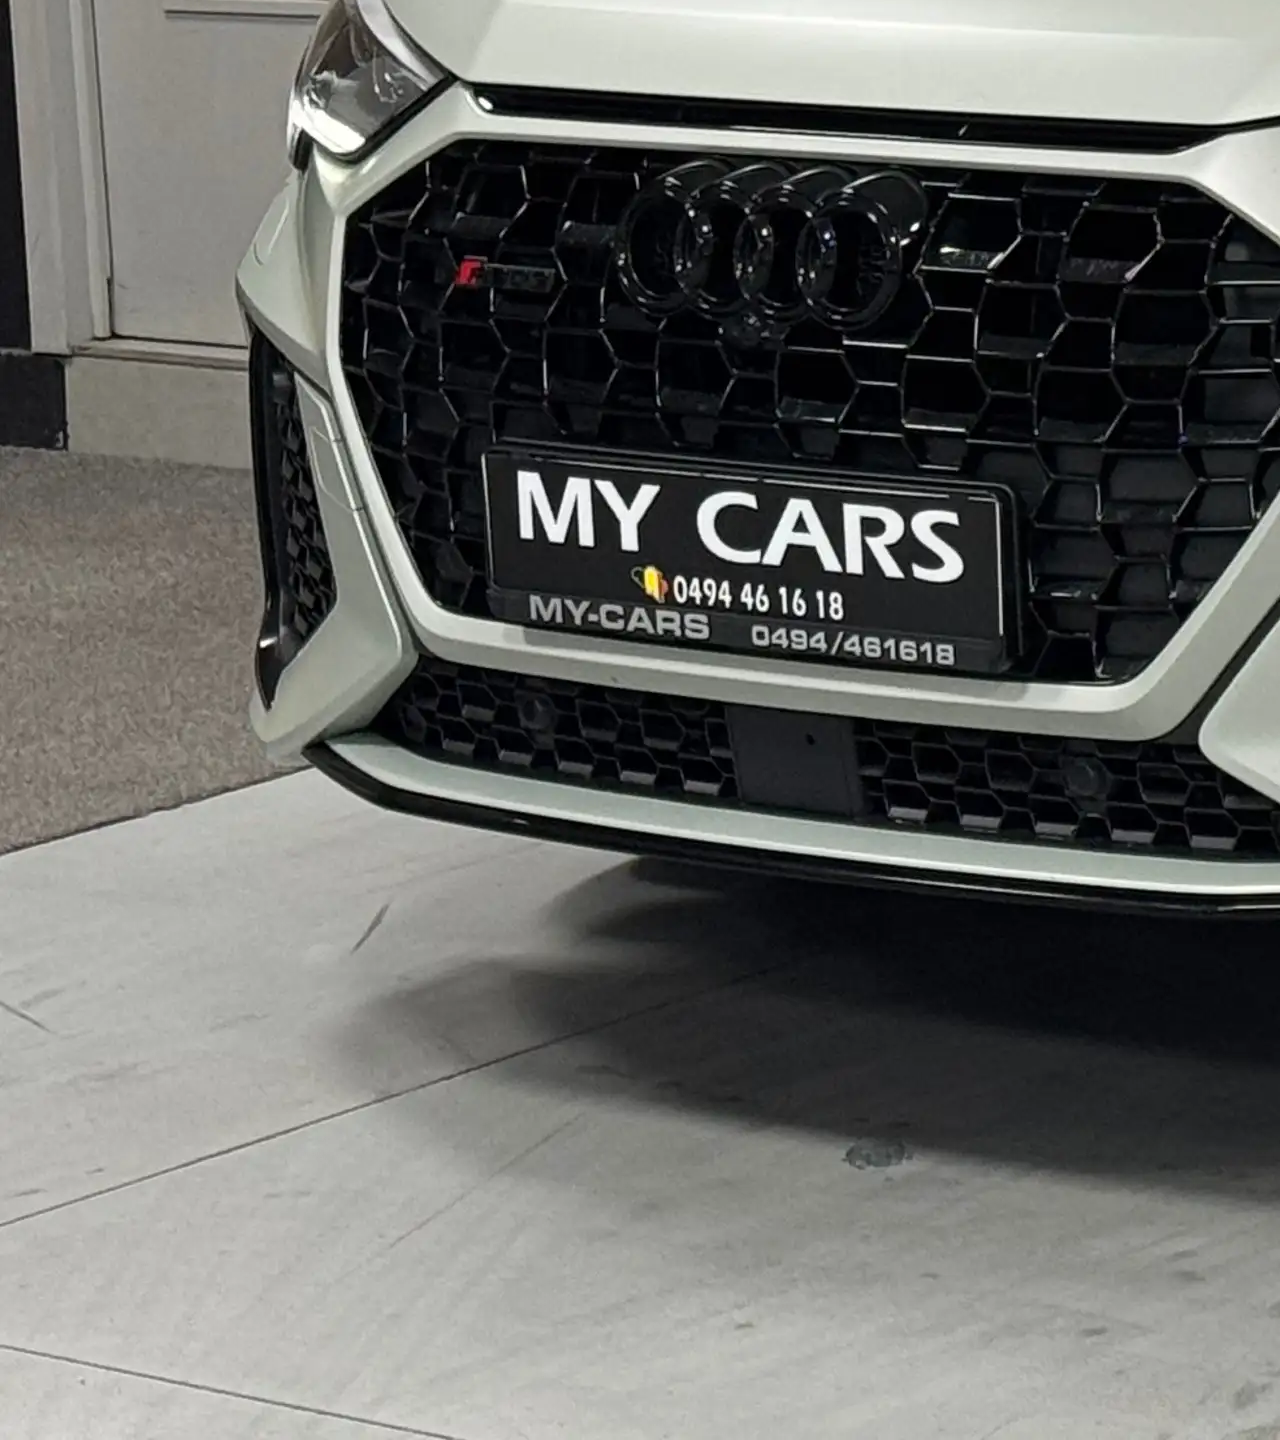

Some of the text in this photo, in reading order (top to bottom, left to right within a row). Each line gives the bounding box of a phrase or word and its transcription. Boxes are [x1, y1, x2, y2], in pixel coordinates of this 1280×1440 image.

[517, 470, 964, 582] MY CARS
[529, 594, 710, 640] MY-CARS
[673, 575, 844, 621] 0494 46 16 18
[751, 624, 955, 666] 0494/461618
